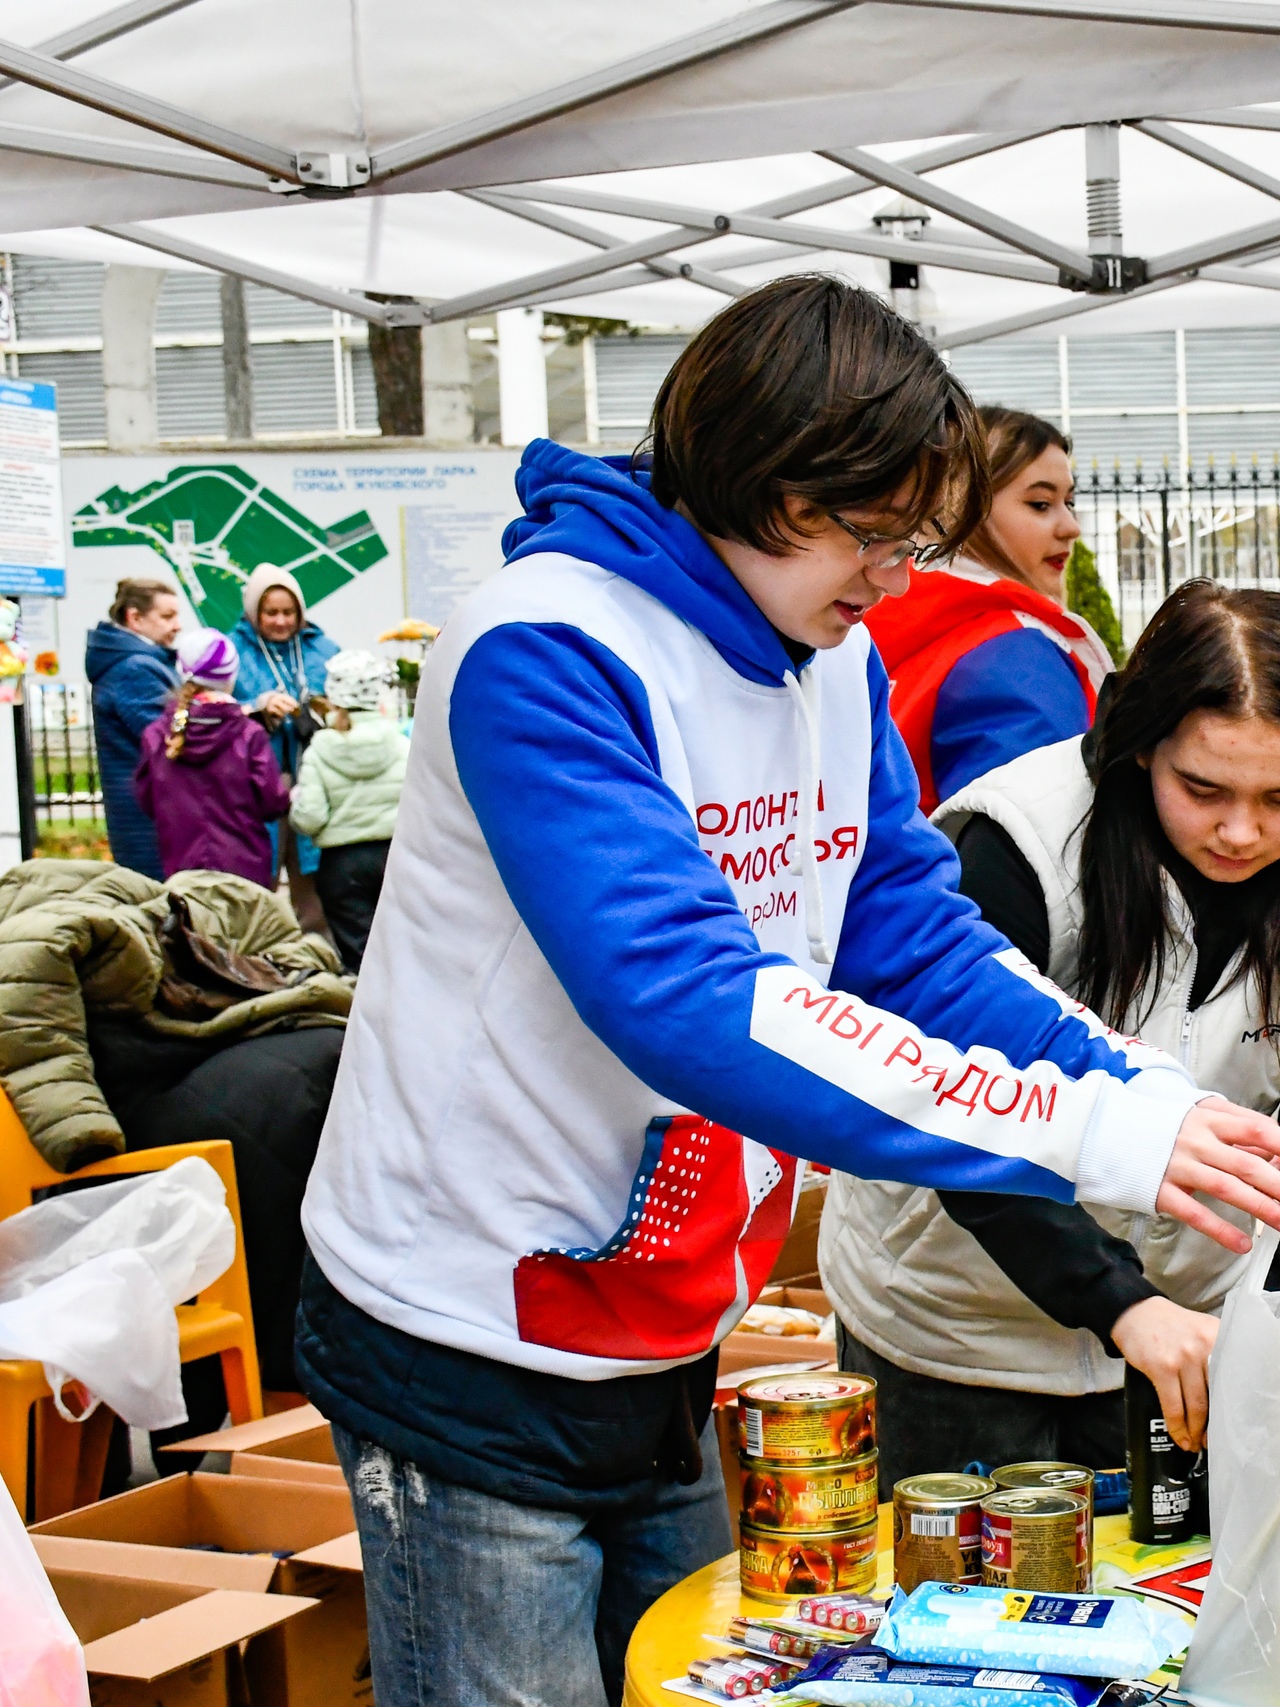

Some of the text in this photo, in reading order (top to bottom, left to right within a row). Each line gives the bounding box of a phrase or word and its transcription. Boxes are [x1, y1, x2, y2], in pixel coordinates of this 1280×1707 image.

[293, 465, 476, 478] СХЕМА ТЕРРИТОРИИ ПАРКА
[293, 478, 446, 492] ГОРОДА ЖУКОВСКОГО
[783, 987, 1058, 1122] МЫ РЯДОМ
[741, 1550, 769, 1575] НКА
